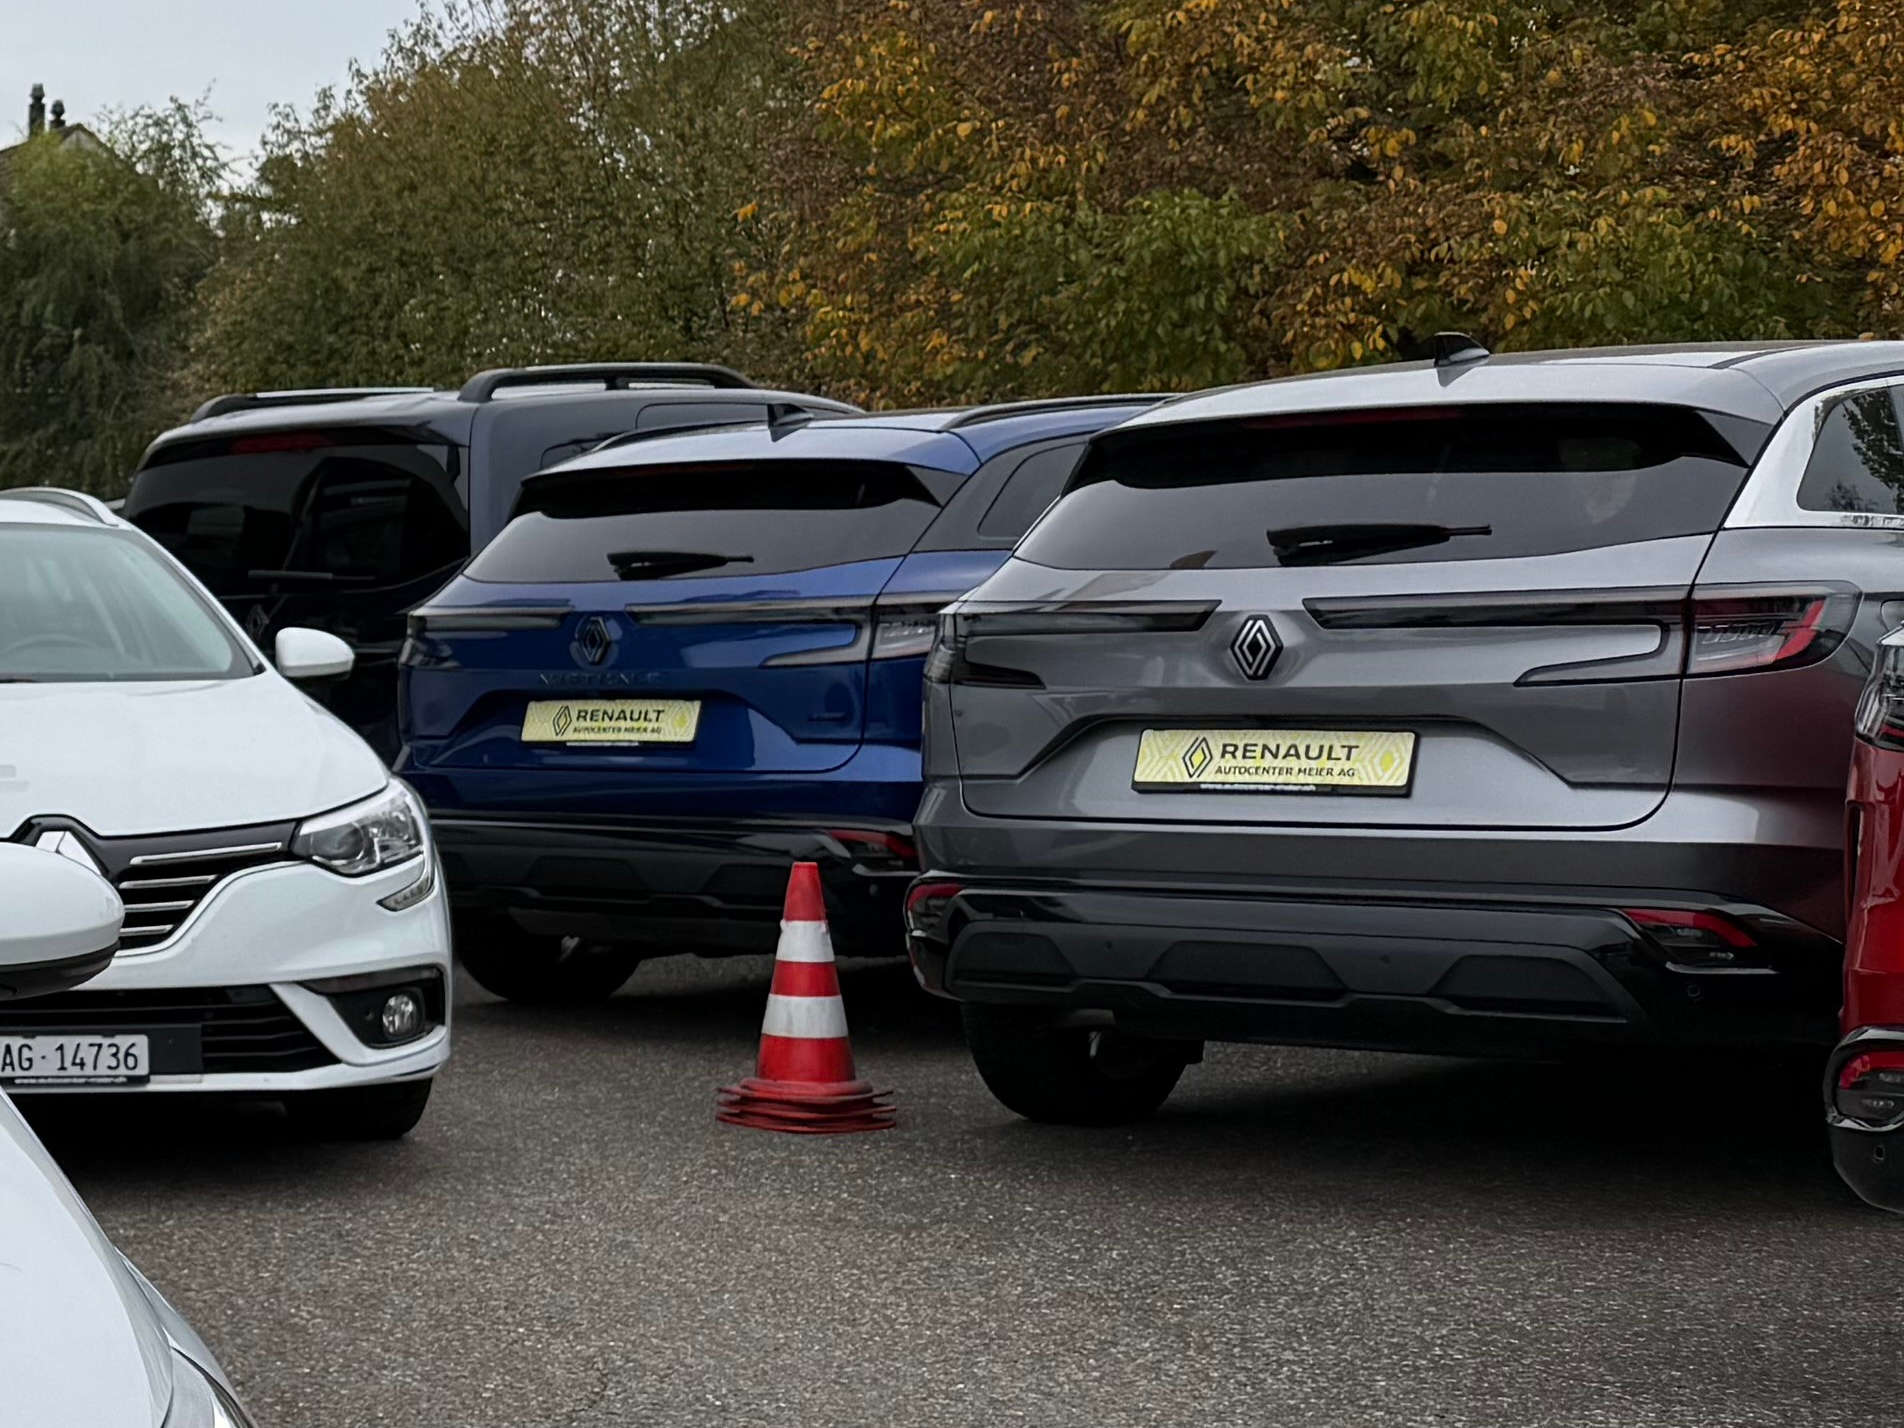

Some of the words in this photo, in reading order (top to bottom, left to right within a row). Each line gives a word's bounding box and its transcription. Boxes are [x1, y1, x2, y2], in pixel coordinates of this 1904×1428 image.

[576, 709, 665, 722] RENAULT
[1220, 743, 1360, 762] RENAULT
[1215, 765, 1293, 776] AUTOCENTER
[1297, 767, 1334, 777] MEIER
[1338, 768, 1356, 778] AG
[55, 1042, 138, 1072] 14736
